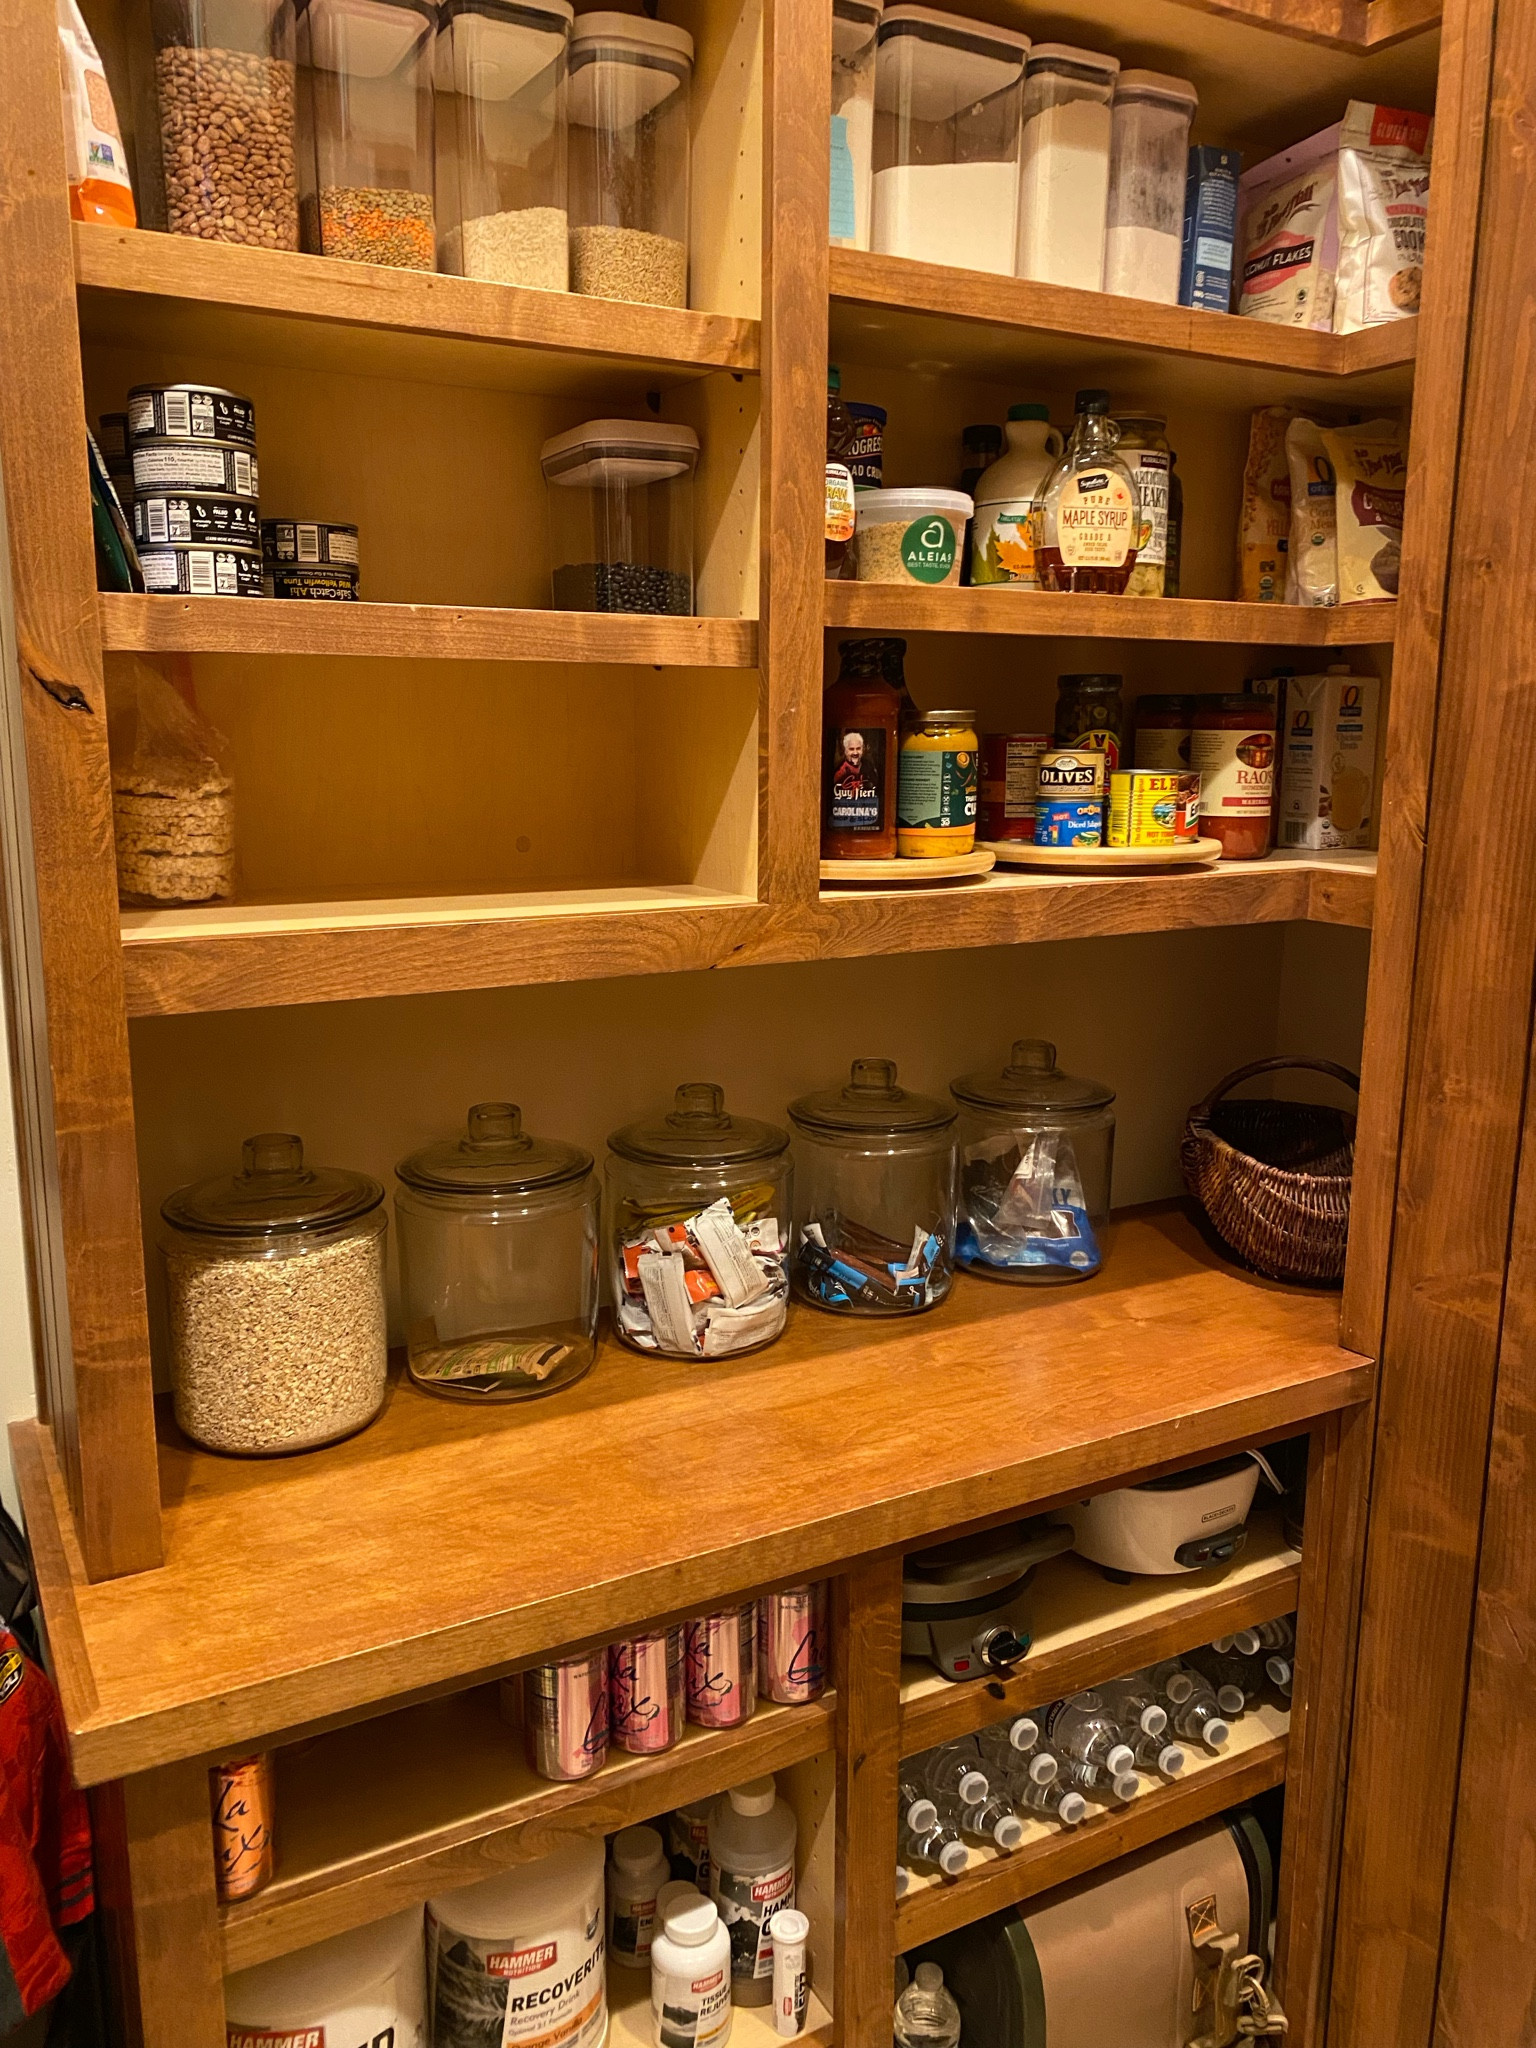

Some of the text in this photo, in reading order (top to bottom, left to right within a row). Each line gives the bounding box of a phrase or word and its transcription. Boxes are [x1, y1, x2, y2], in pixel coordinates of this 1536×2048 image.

[1272, 245, 1312, 266] FLAKES
[826, 486, 848, 501] RAW
[1083, 495, 1111, 506] PURE
[1062, 509, 1128, 531] MAPLE SYRUP
[1079, 532, 1104, 541] GRADE
[283, 578, 303, 586] Tuna
[289, 587, 308, 597] Ahi
[1041, 769, 1093, 784] OLIVES
[1149, 778, 1168, 791] EL
[1068, 821, 1086, 829] Diced
[755, 1872, 792, 1898] HAMMER
[489, 1945, 554, 1969] HAMMER
[503, 1963, 542, 1977] NUTRITION
[510, 1990, 580, 2026] Recovery Drink
[554, 2017, 583, 2042] Vanilla
[229, 2031, 320, 2048] HAMMER
